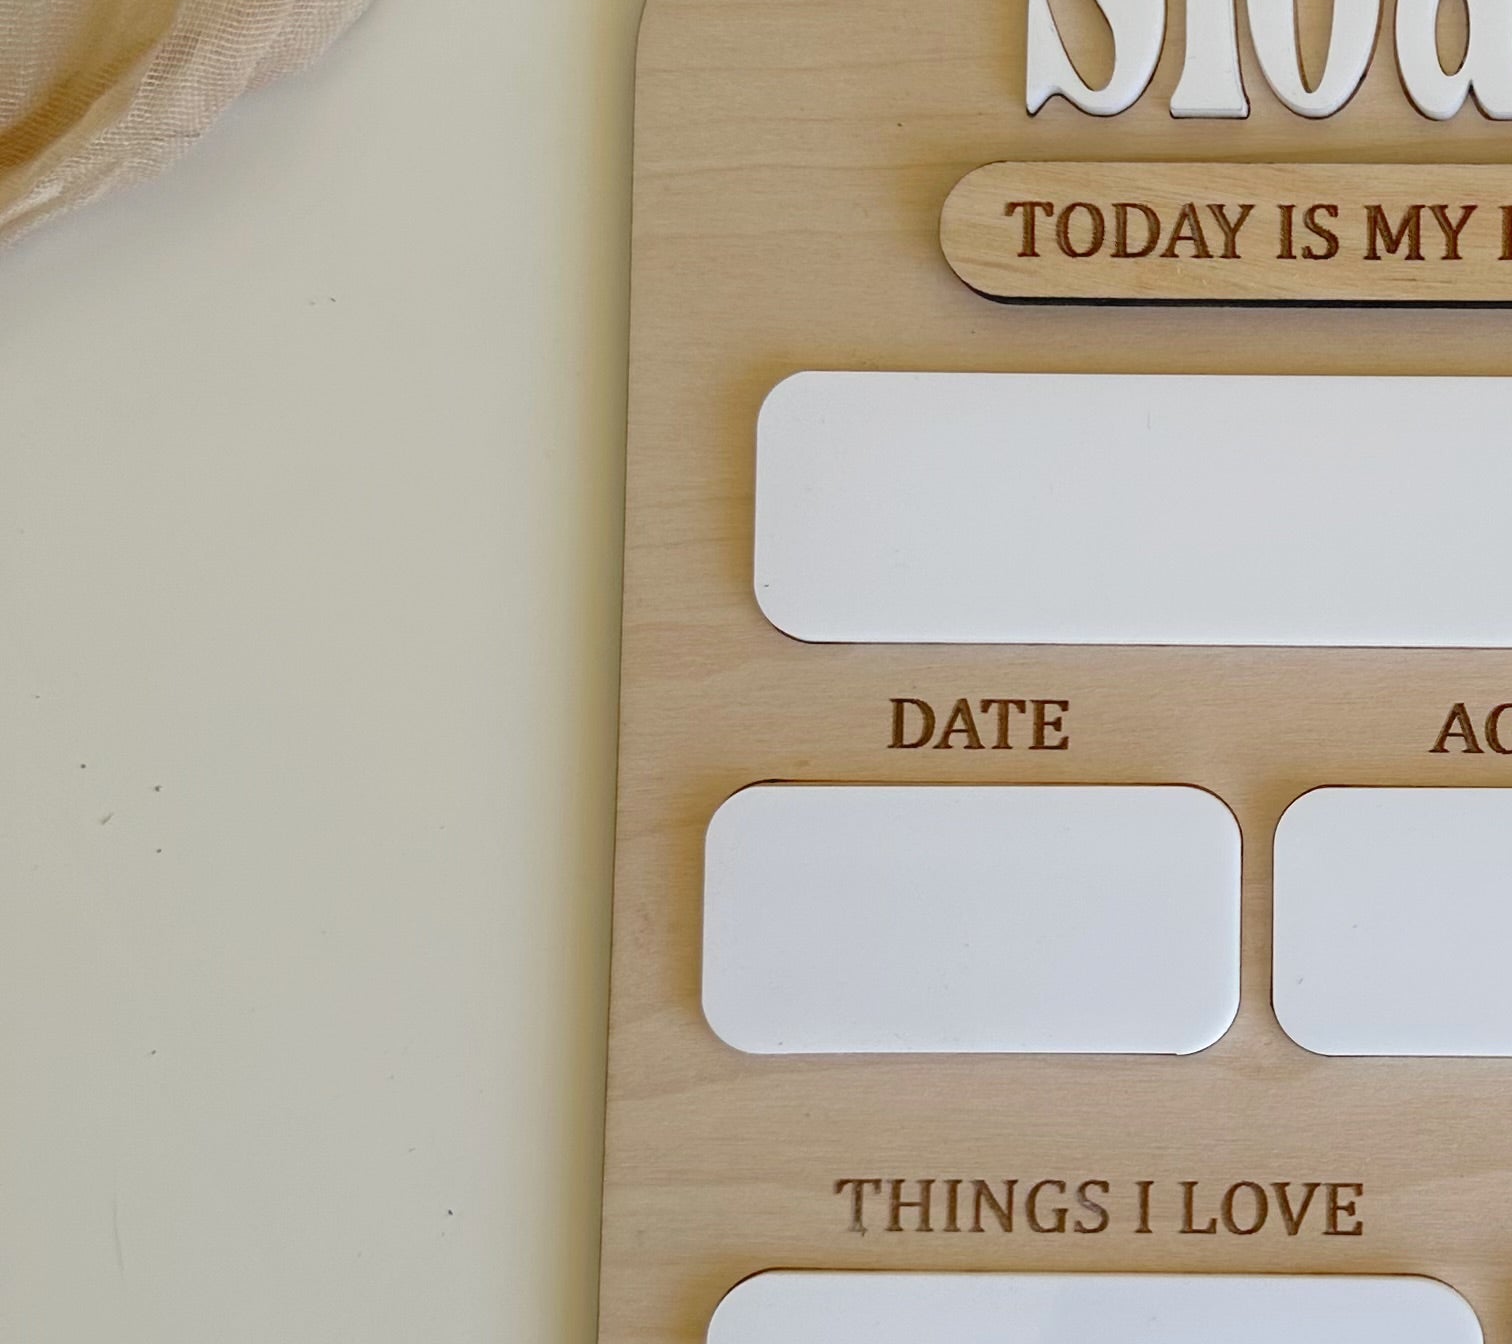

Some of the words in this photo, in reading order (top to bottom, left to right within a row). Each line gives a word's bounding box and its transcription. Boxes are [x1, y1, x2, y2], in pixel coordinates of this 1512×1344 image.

[1003, 200, 1257, 260] TODAY
[1275, 203, 1341, 261] IS
[1362, 203, 1479, 262] MY
[886, 697, 1070, 751] DATE
[833, 1178, 1110, 1236] THINGS
[1133, 1180, 1155, 1234] I
[1177, 1180, 1364, 1237] LOVE
